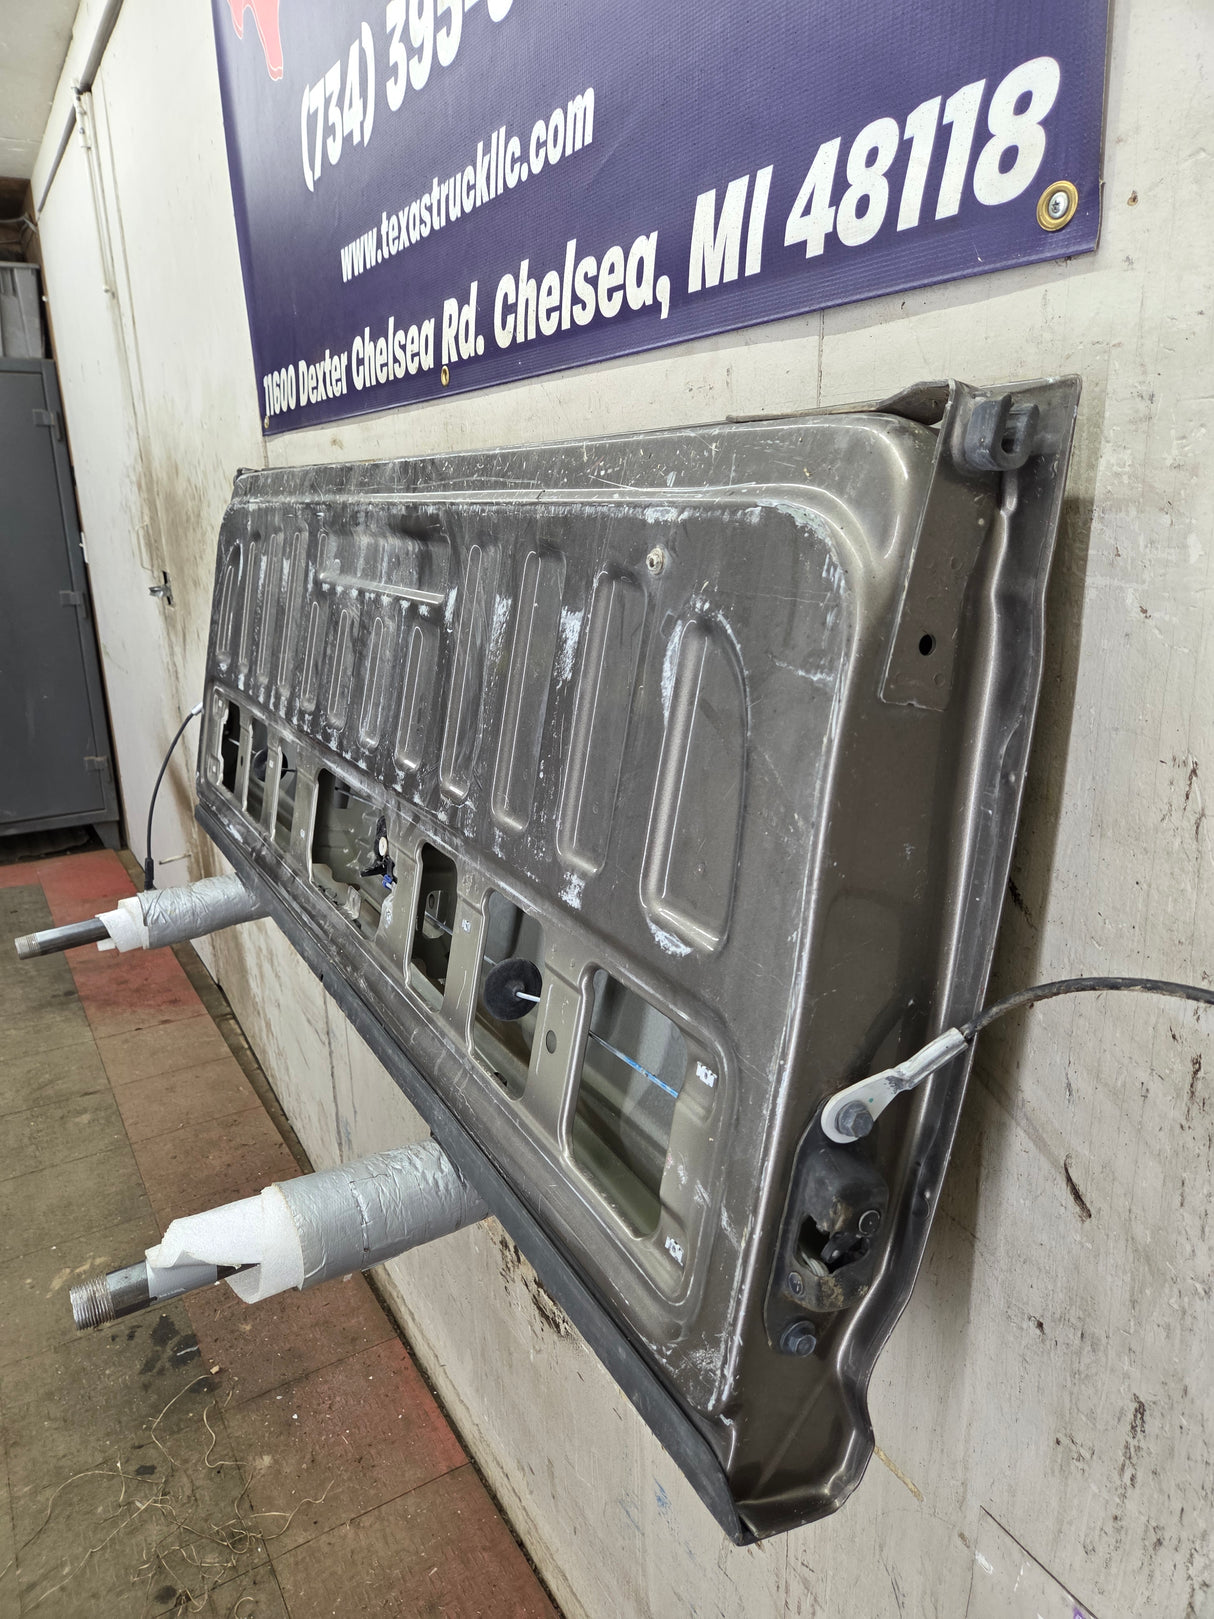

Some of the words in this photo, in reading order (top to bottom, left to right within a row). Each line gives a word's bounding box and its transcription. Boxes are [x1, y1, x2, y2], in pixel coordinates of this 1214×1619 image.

[301, 22, 375, 192] (734)
[386, 0, 514, 112] 395-
[340, 87, 595, 283] www.texastruckllc.com
[263, 364, 297, 416] 11600
[299, 349, 348, 407] Dexter
[351, 316, 435, 391] Chelsea
[441, 280, 485, 365] Rd.
[494, 231, 671, 349] Chelsea,
[688, 164, 774, 293] MI
[784, 56, 1061, 259] 48118
